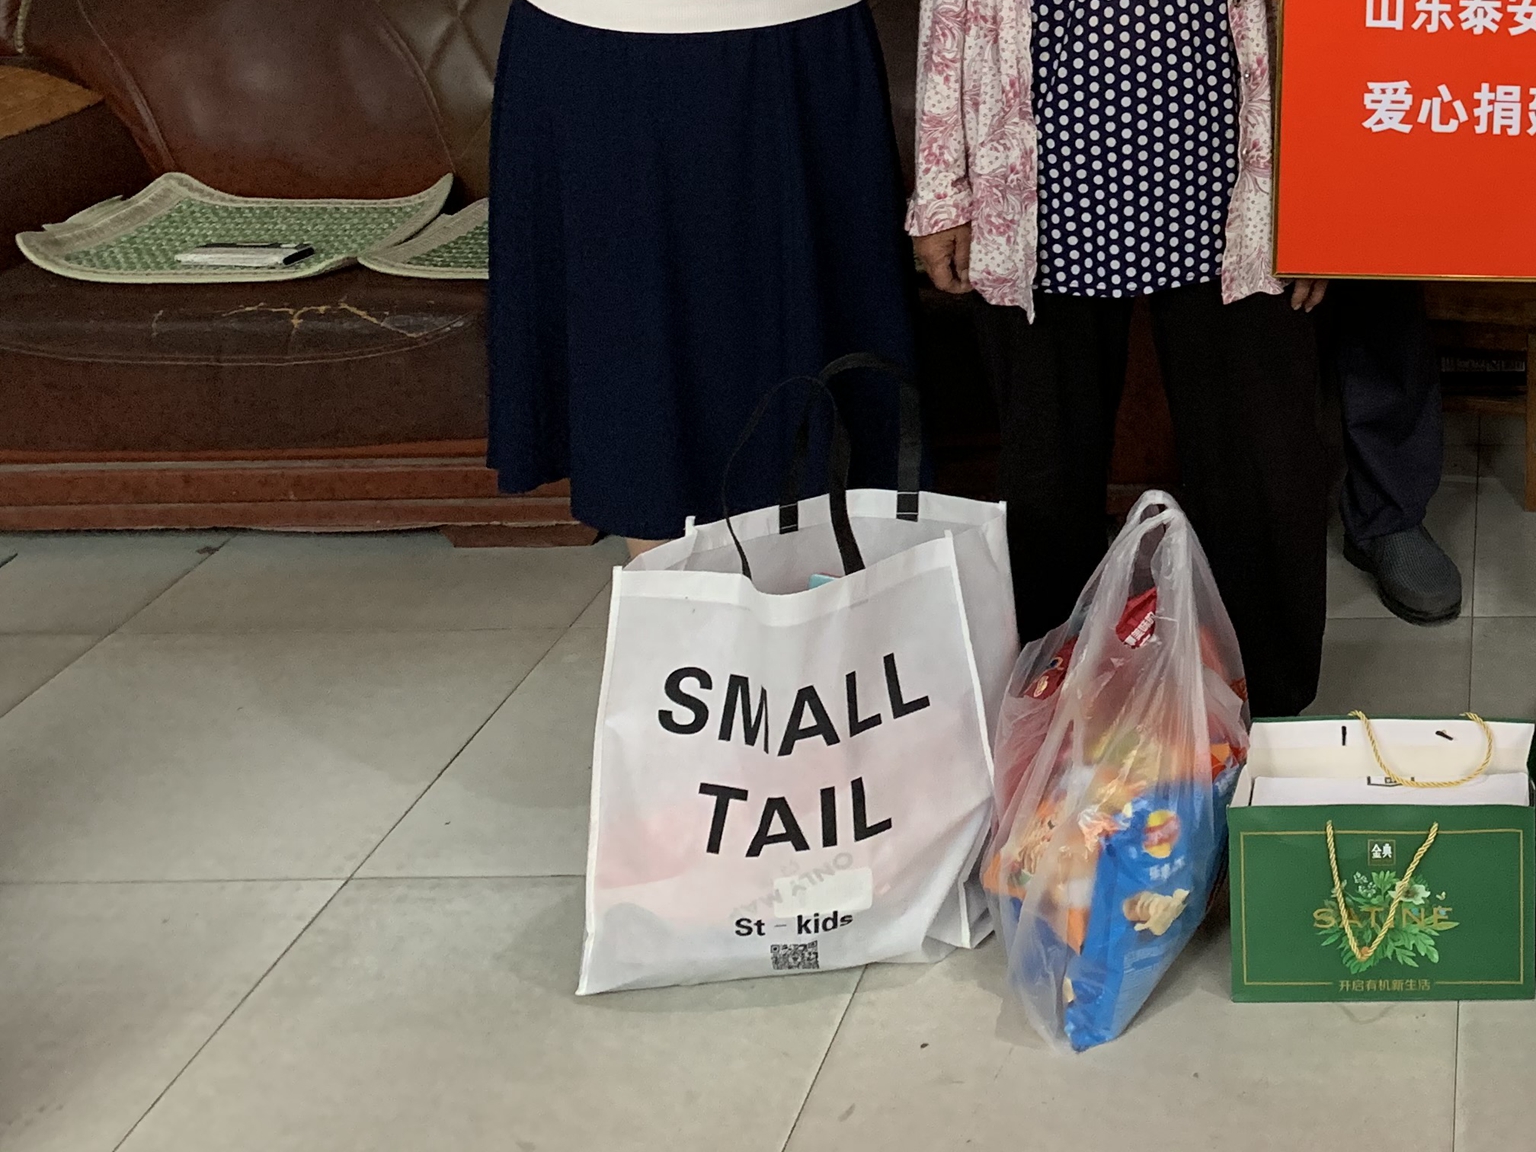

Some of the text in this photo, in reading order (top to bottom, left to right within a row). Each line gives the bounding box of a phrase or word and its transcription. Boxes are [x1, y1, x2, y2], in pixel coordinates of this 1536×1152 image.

[658, 652, 930, 757] SMALL
[698, 776, 892, 858] TAIL
[1371, 843, 1393, 860] 金典
[735, 918, 766, 937] St
[797, 910, 853, 935] kids
[1338, 979, 1431, 992] 开启有机新生活
